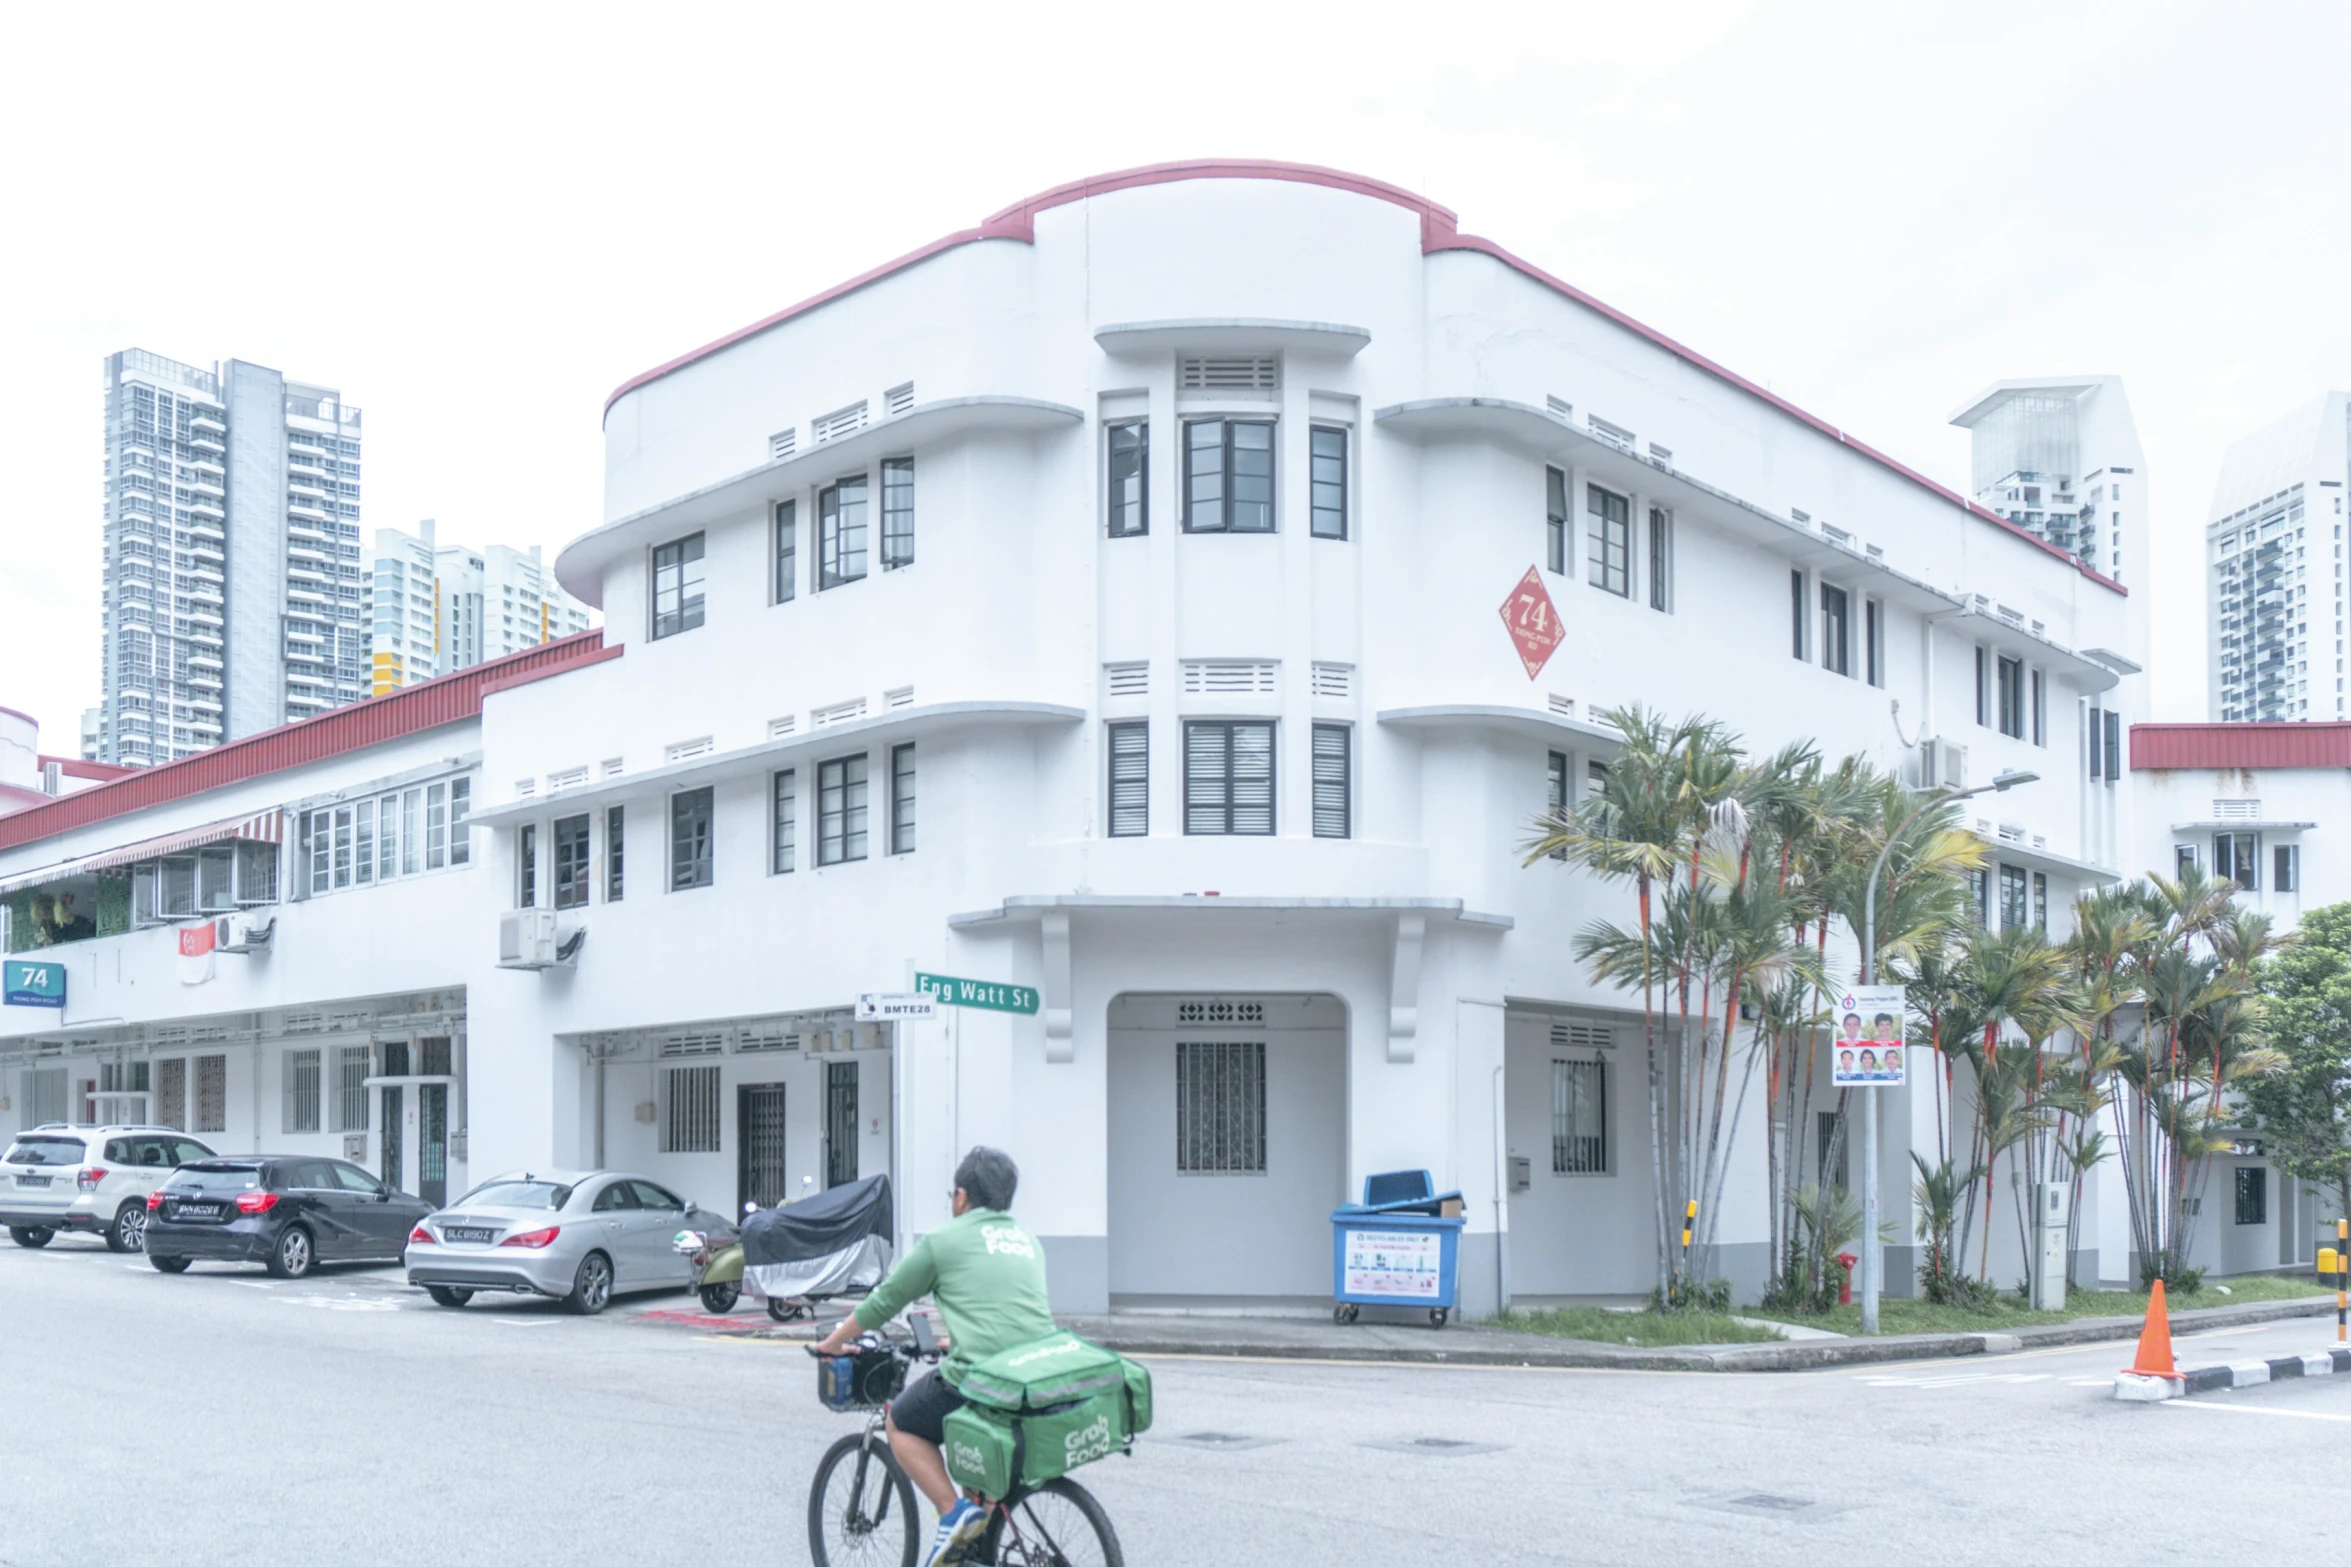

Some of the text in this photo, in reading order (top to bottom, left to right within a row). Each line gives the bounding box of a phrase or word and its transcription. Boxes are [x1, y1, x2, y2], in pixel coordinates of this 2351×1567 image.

[1518, 593, 1548, 633] 74
[22, 967, 48, 988] 74
[920, 976, 1030, 1007] Eng Watt St
[884, 1005, 931, 1014] BMTE28
[985, 1239, 1035, 1260] Food
[1064, 1413, 1109, 1451] Grab
[954, 1440, 984, 1465] Grab
[1065, 1429, 1111, 1469] Food
[955, 1454, 987, 1475] Food
